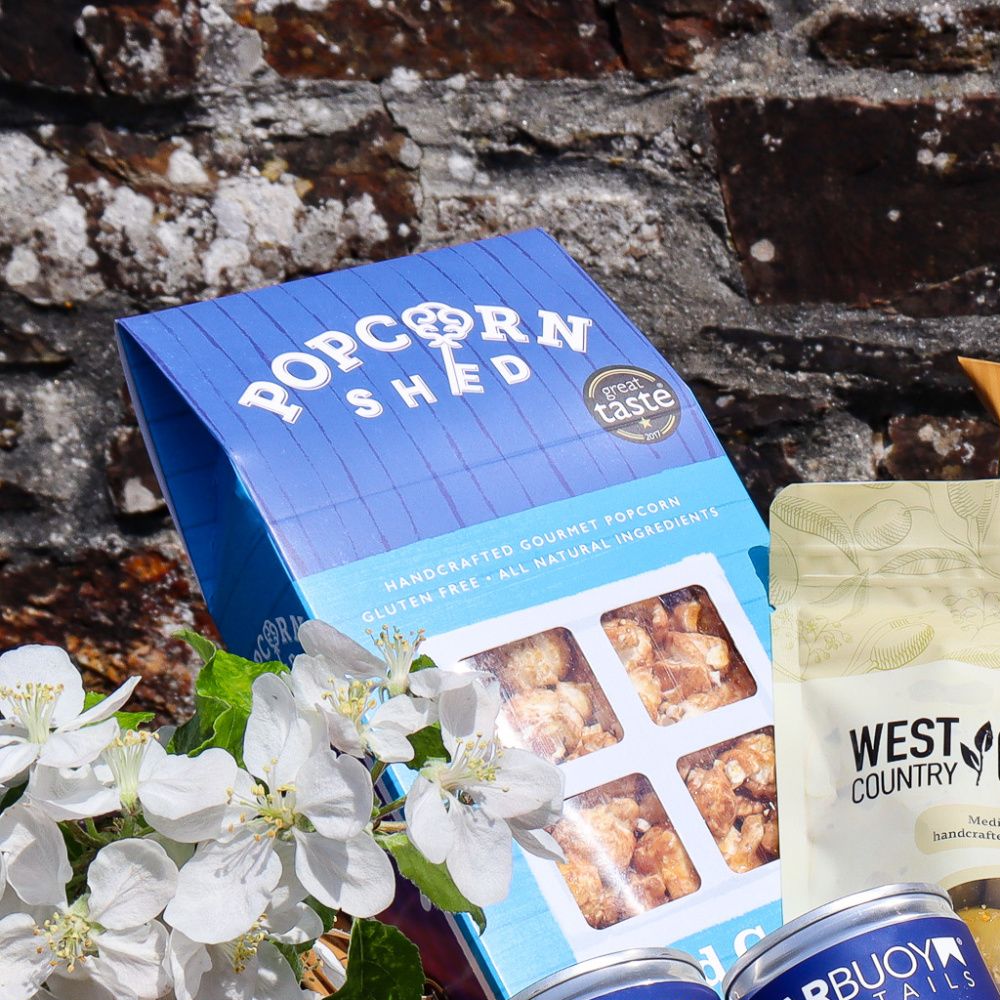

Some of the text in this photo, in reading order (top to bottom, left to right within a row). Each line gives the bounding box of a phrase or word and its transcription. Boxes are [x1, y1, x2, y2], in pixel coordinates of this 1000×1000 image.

[238, 302, 592, 424] POPCORN
[346, 354, 532, 419] SHED
[601, 376, 644, 401] great
[594, 389, 675, 424] taste
[644, 430, 661, 441] 2017
[361, 506, 720, 624] GLUTEN FREE ALL NATURAL INGREDIENTS
[384, 495, 682, 593] HANDCRAFTED GOURMET POPCORN
[849, 716, 960, 773] WEST
[851, 761, 959, 805] COUNTRY
